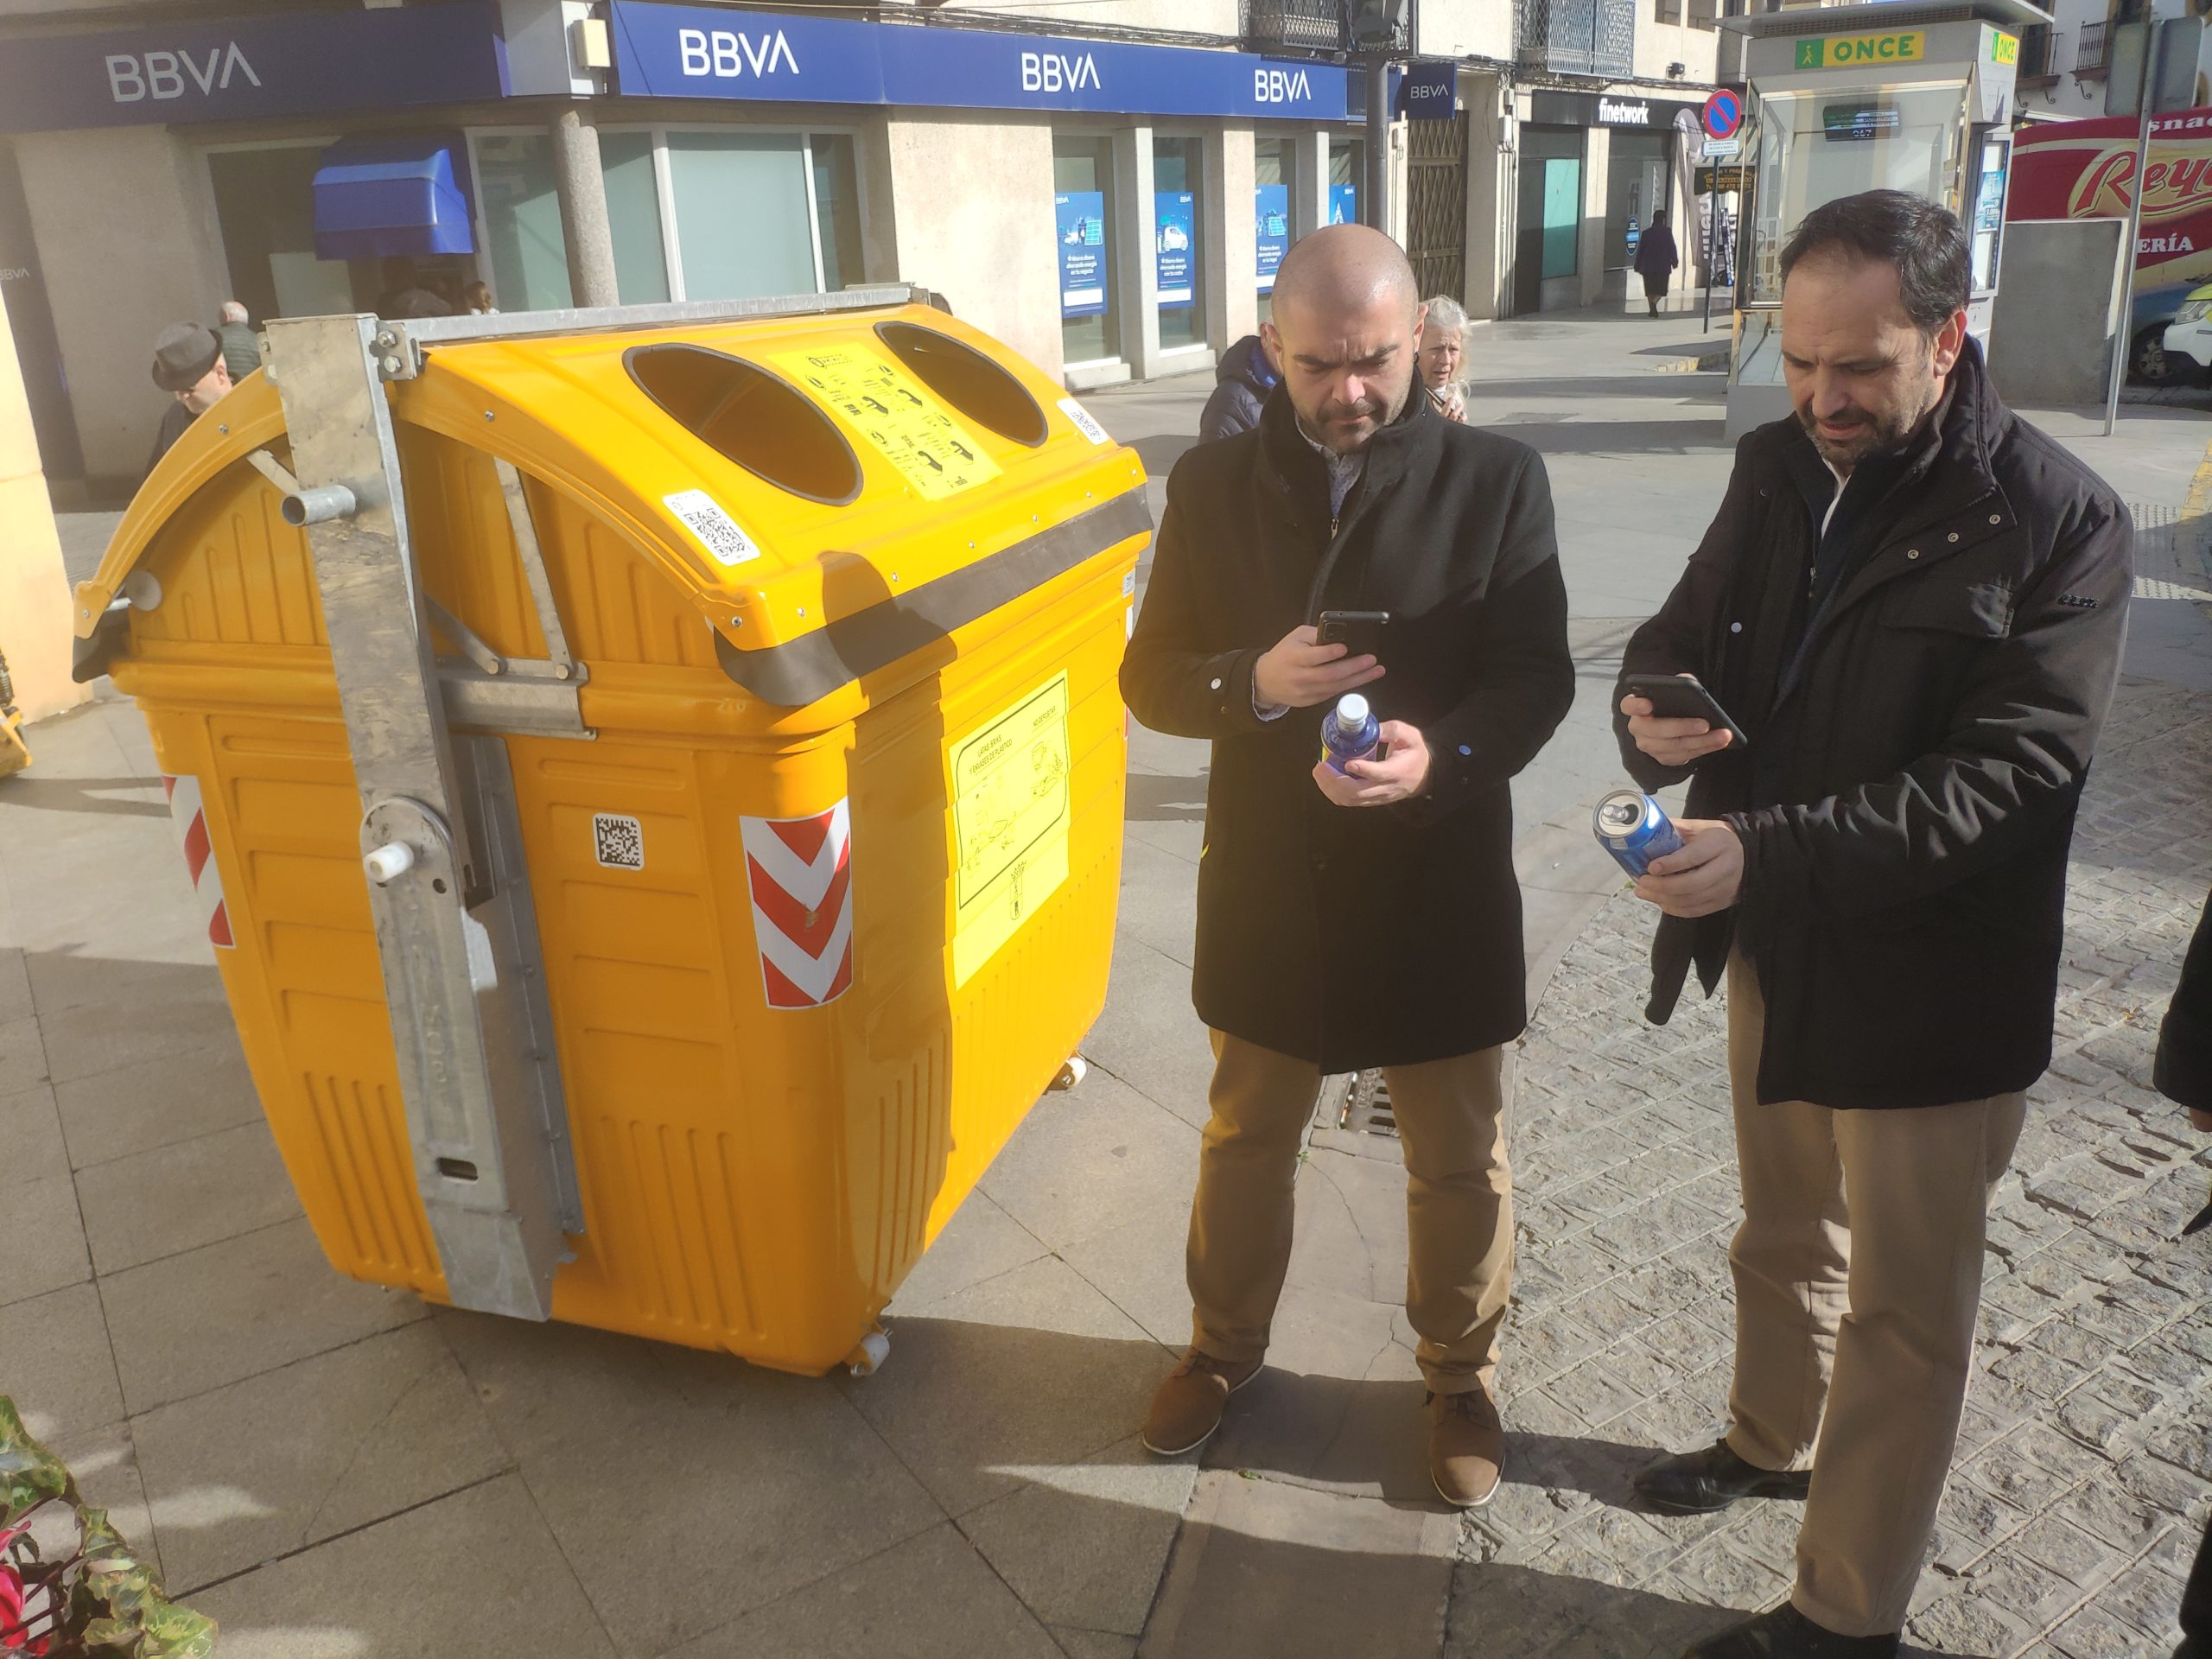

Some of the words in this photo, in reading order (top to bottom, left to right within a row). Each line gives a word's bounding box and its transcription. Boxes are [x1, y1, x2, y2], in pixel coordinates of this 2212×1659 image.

[679, 29, 799, 79] BBVA
[1834, 35, 1915, 61] ONCE
[1999, 38, 2015, 60] ONCE
[105, 41, 261, 102] BBVA
[1021, 52, 1101, 92] BBVA
[1255, 69, 1312, 103] BBVA
[1410, 84, 1449, 99] BBVA
[1599, 97, 1649, 124] finetwork
